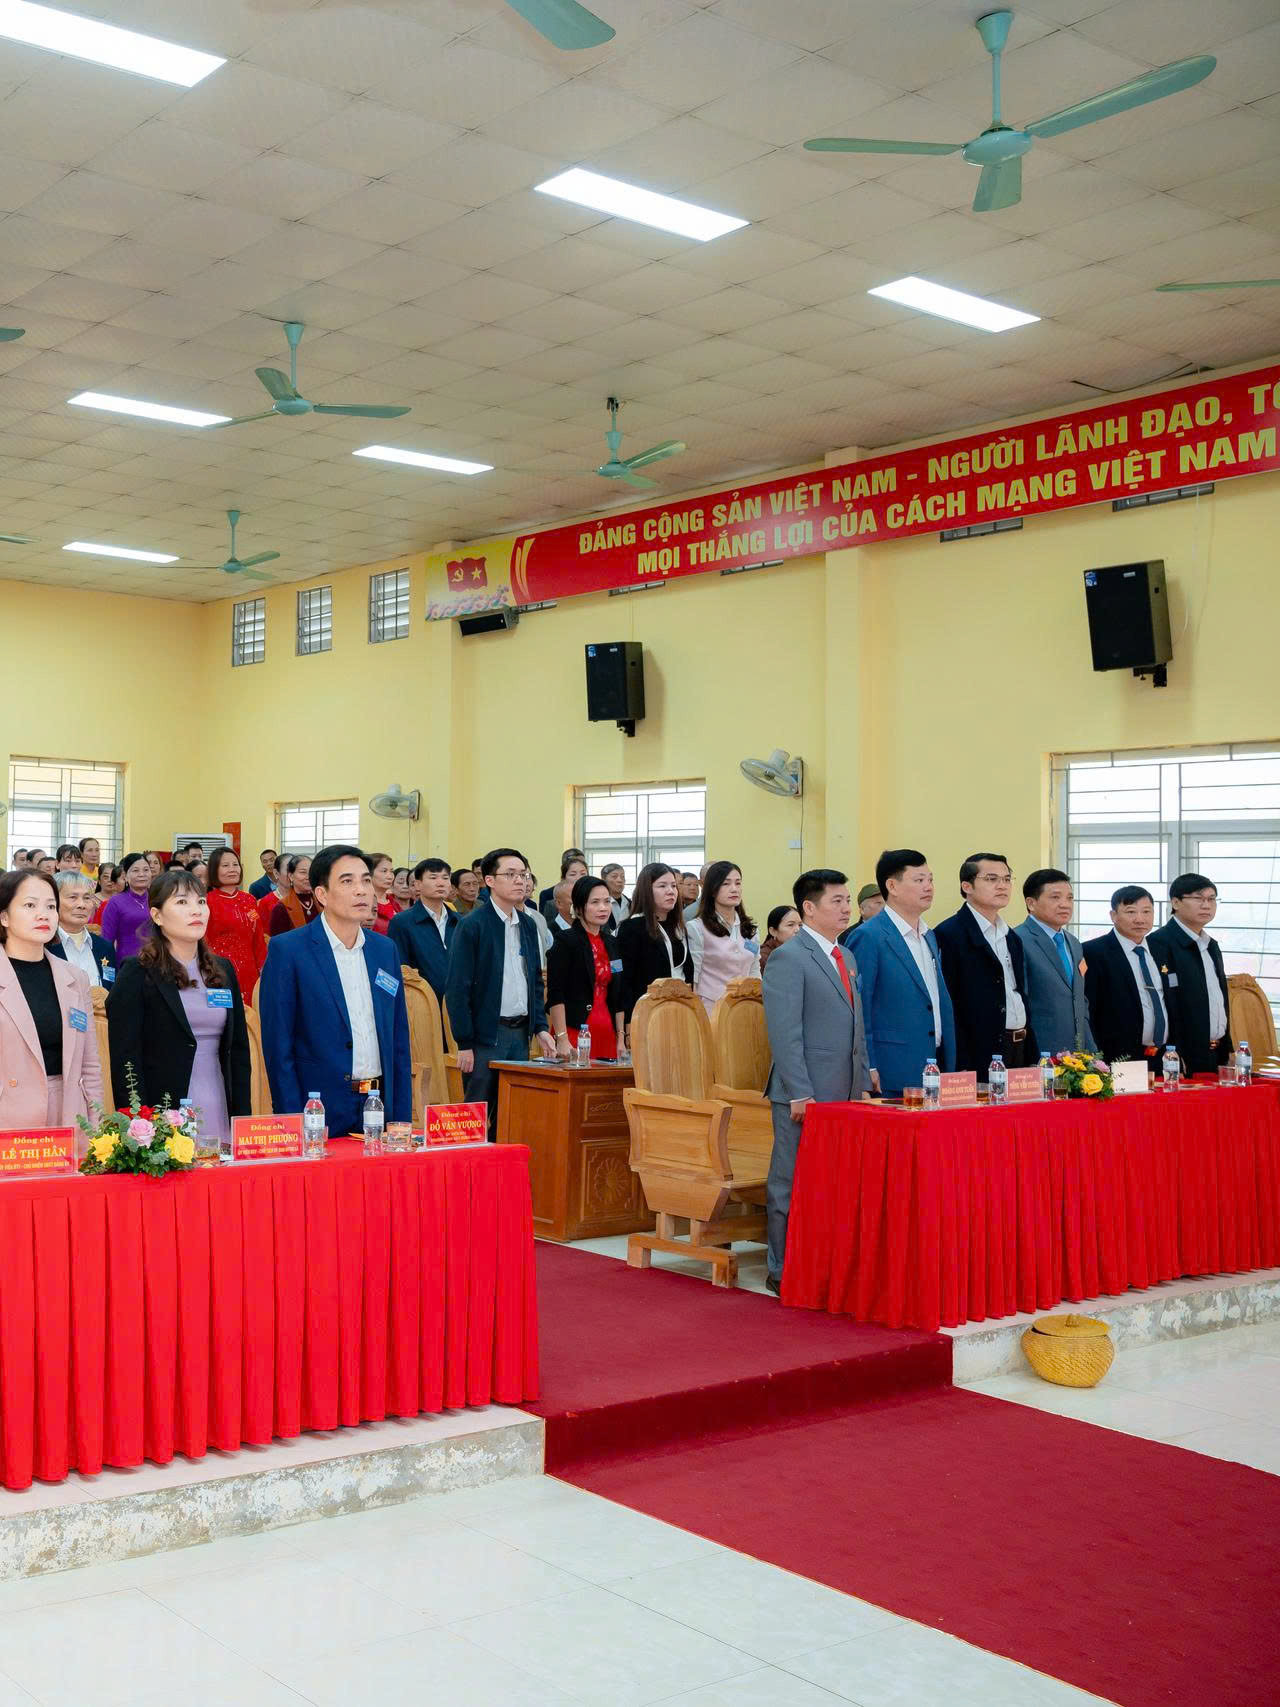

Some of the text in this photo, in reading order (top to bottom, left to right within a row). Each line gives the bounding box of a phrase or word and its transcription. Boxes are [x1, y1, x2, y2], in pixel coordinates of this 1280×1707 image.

[579, 519, 636, 555] ĐẢNG
[643, 511, 705, 543] CỘNG
[711, 491, 762, 528] SẢN
[769, 483, 824, 514] VIỆT
[832, 466, 897, 504] NAM
[928, 435, 1024, 483] NGƯỜI
[1036, 415, 1128, 461] LÃNH
[1140, 395, 1233, 439] ĐẠO,
[637, 428, 1277, 578] MỌI THẮNG LỢI CỦA CÁCH MẠNG VIỆT NAM
[1, 1147, 16, 1160] LÊ
[19, 1148, 40, 1160] THỊ
[238, 1136, 252, 1146] MAI
[254, 1135, 266, 1146] THỊ
